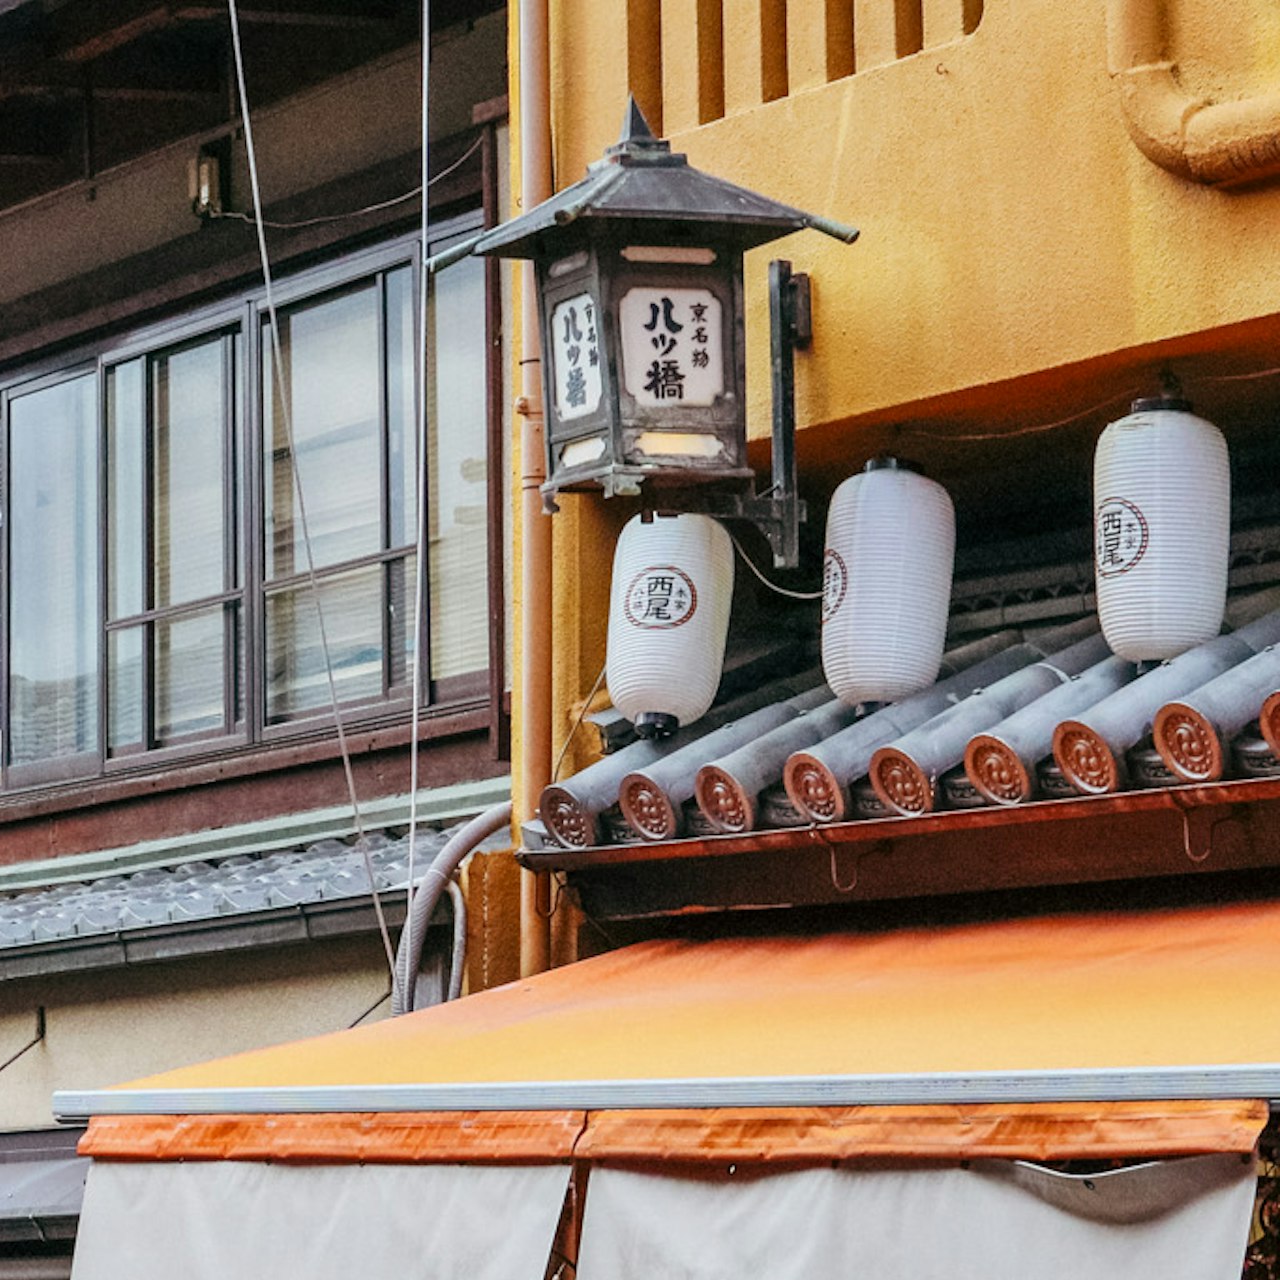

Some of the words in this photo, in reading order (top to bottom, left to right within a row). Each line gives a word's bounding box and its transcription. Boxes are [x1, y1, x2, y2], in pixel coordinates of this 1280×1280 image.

[689, 303, 709, 368] 京名物
[642, 576, 675, 620] 西尾
